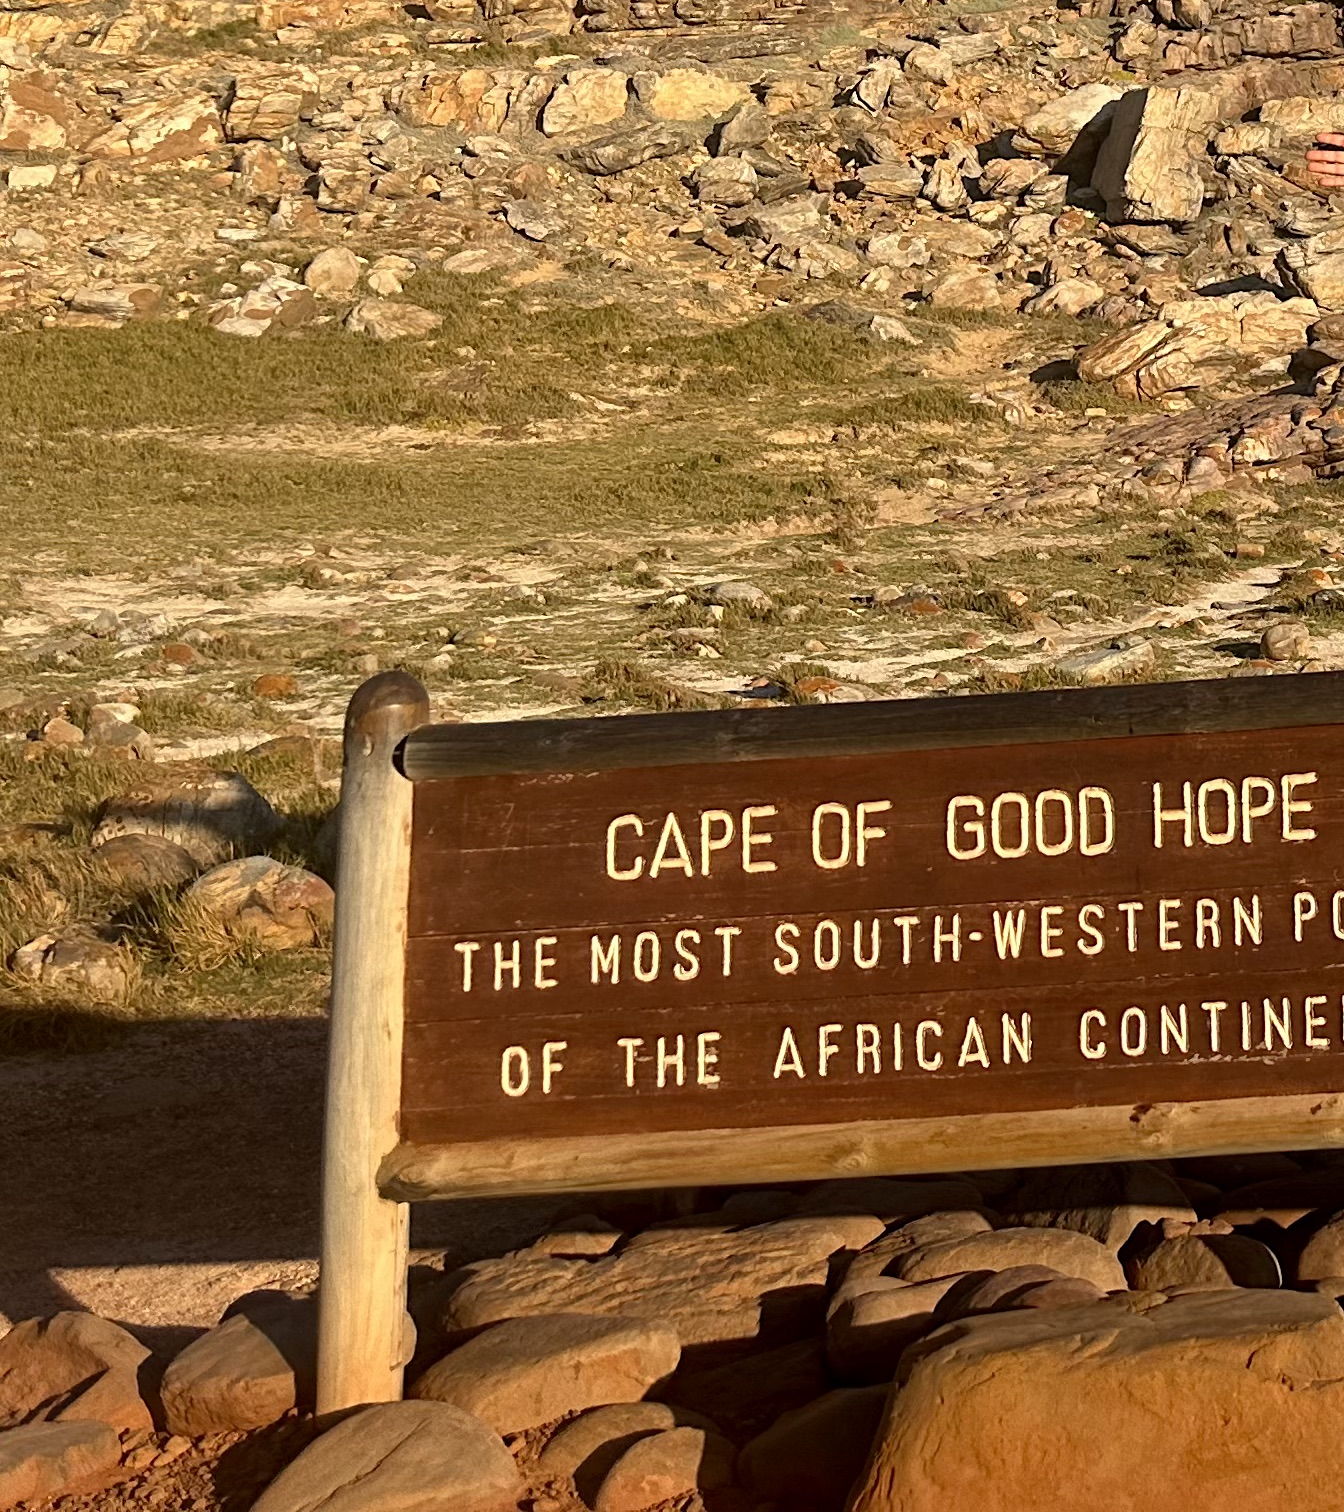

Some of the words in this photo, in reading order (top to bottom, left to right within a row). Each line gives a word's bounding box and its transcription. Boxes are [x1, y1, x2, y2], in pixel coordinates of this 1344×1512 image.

[606, 803, 779, 880] CAPE
[812, 799, 893, 870] OF
[946, 786, 1115, 860] GOOD
[1152, 770, 1319, 846] HOPE
[454, 935, 559, 992] THE
[589, 924, 743, 984] MOST
[772, 893, 1263, 974] SOUTH-WESTERN
[499, 1040, 569, 1097] OF
[618, 1031, 723, 1086] THE
[772, 1012, 1034, 1078] AFRICAN
